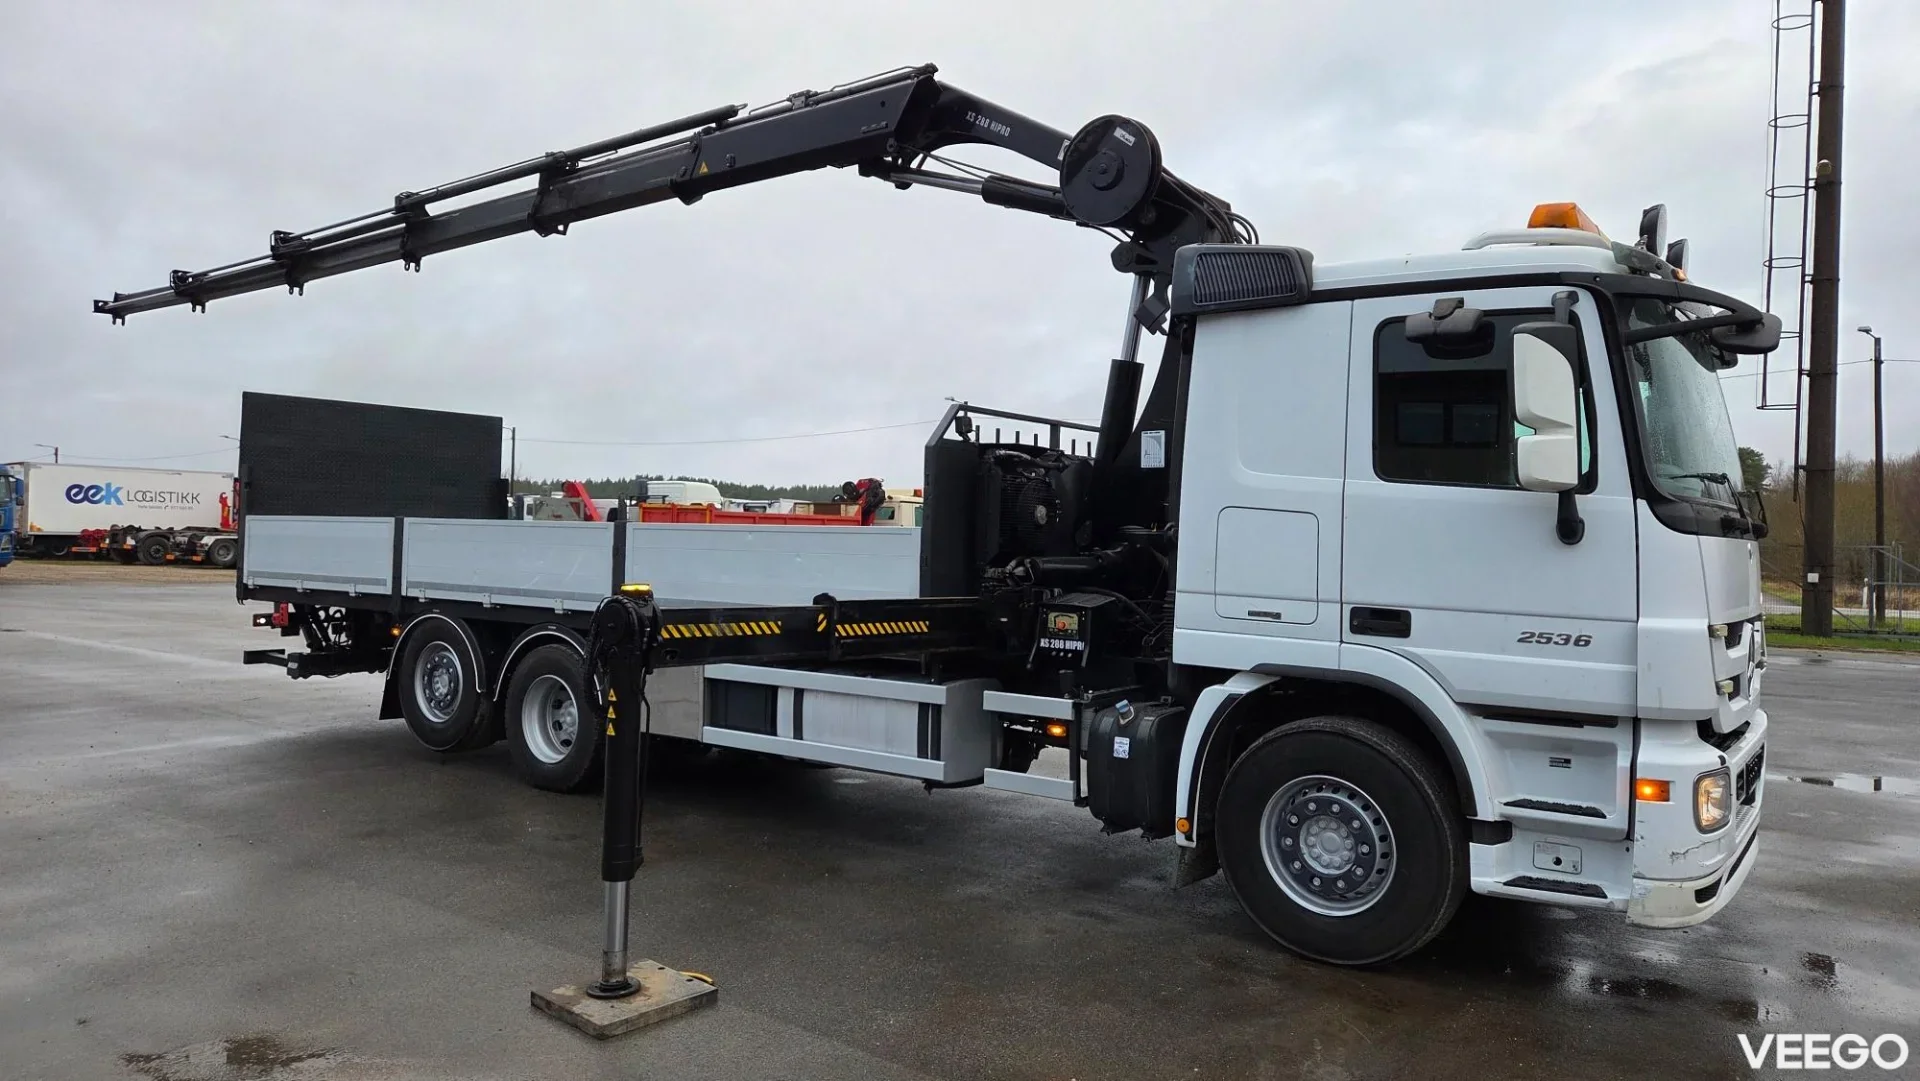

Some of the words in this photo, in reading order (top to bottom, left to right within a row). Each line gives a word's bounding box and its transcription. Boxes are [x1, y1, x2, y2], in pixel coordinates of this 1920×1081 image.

[966, 111, 976, 122] XS
[990, 120, 1011, 137] HIPRO
[65, 482, 124, 506] eek
[126, 490, 200, 504] LOGISTIKK
[1040, 638, 1050, 648] XS
[1517, 631, 1593, 648] 2536
